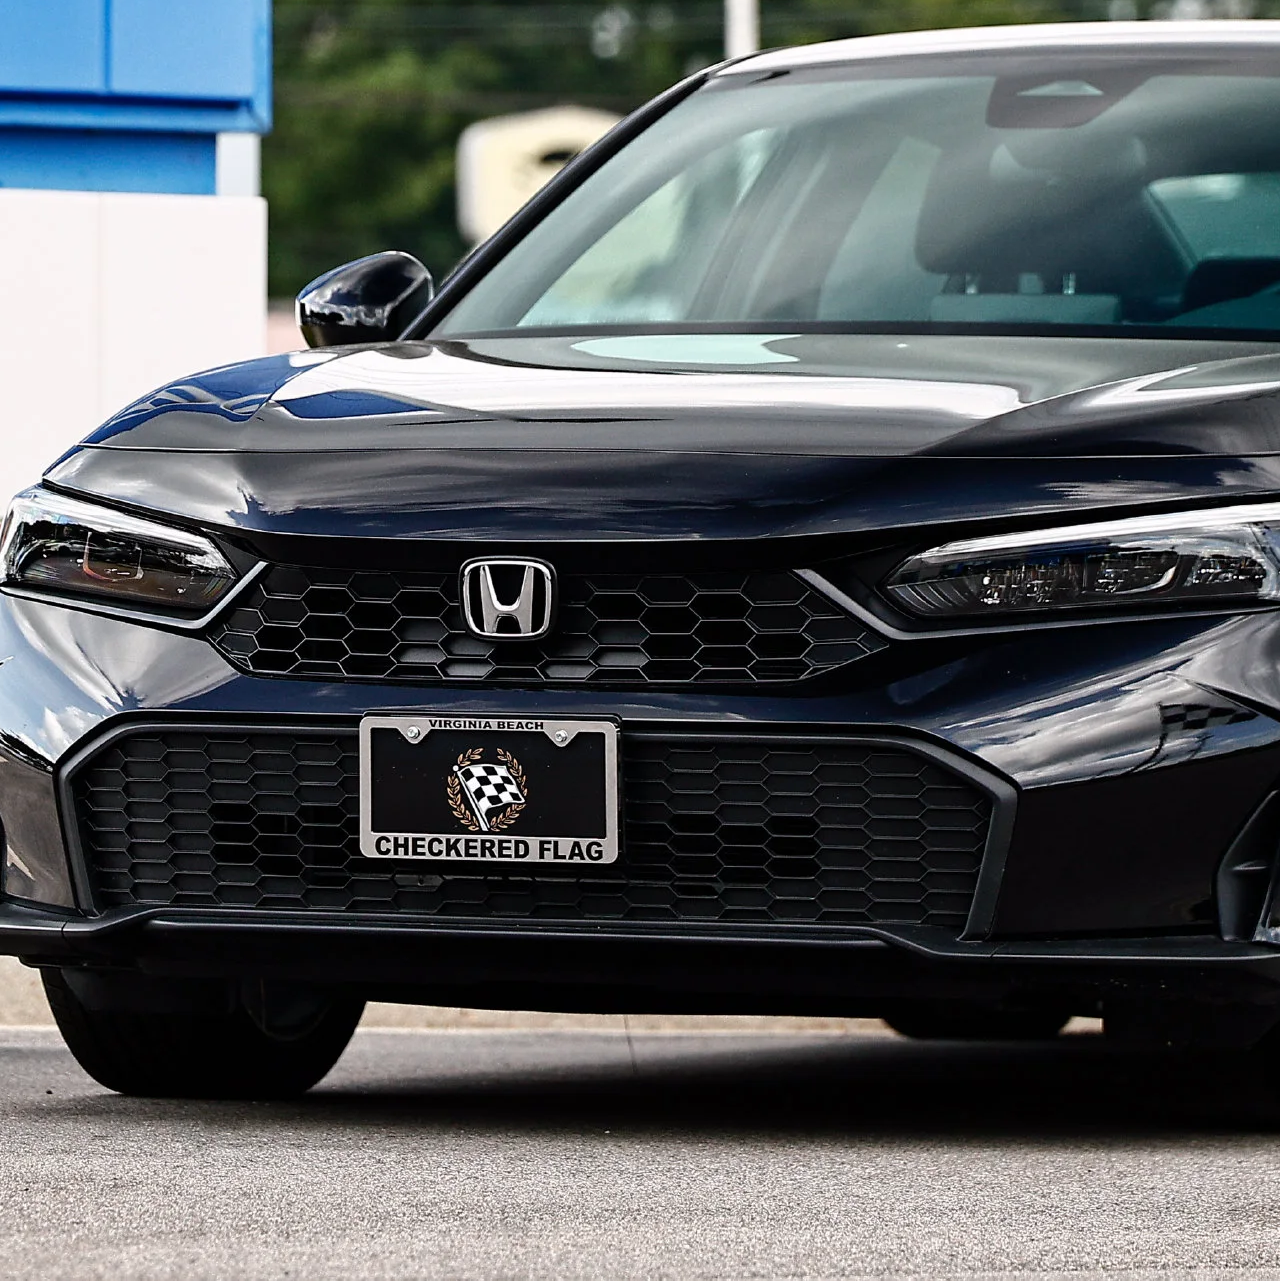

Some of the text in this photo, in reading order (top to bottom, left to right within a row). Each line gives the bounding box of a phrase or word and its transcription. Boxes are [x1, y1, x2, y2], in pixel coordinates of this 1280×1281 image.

[428, 719, 544, 731] VIRGINIA BEACH
[375, 835, 604, 861] CHECKERED FLAG
